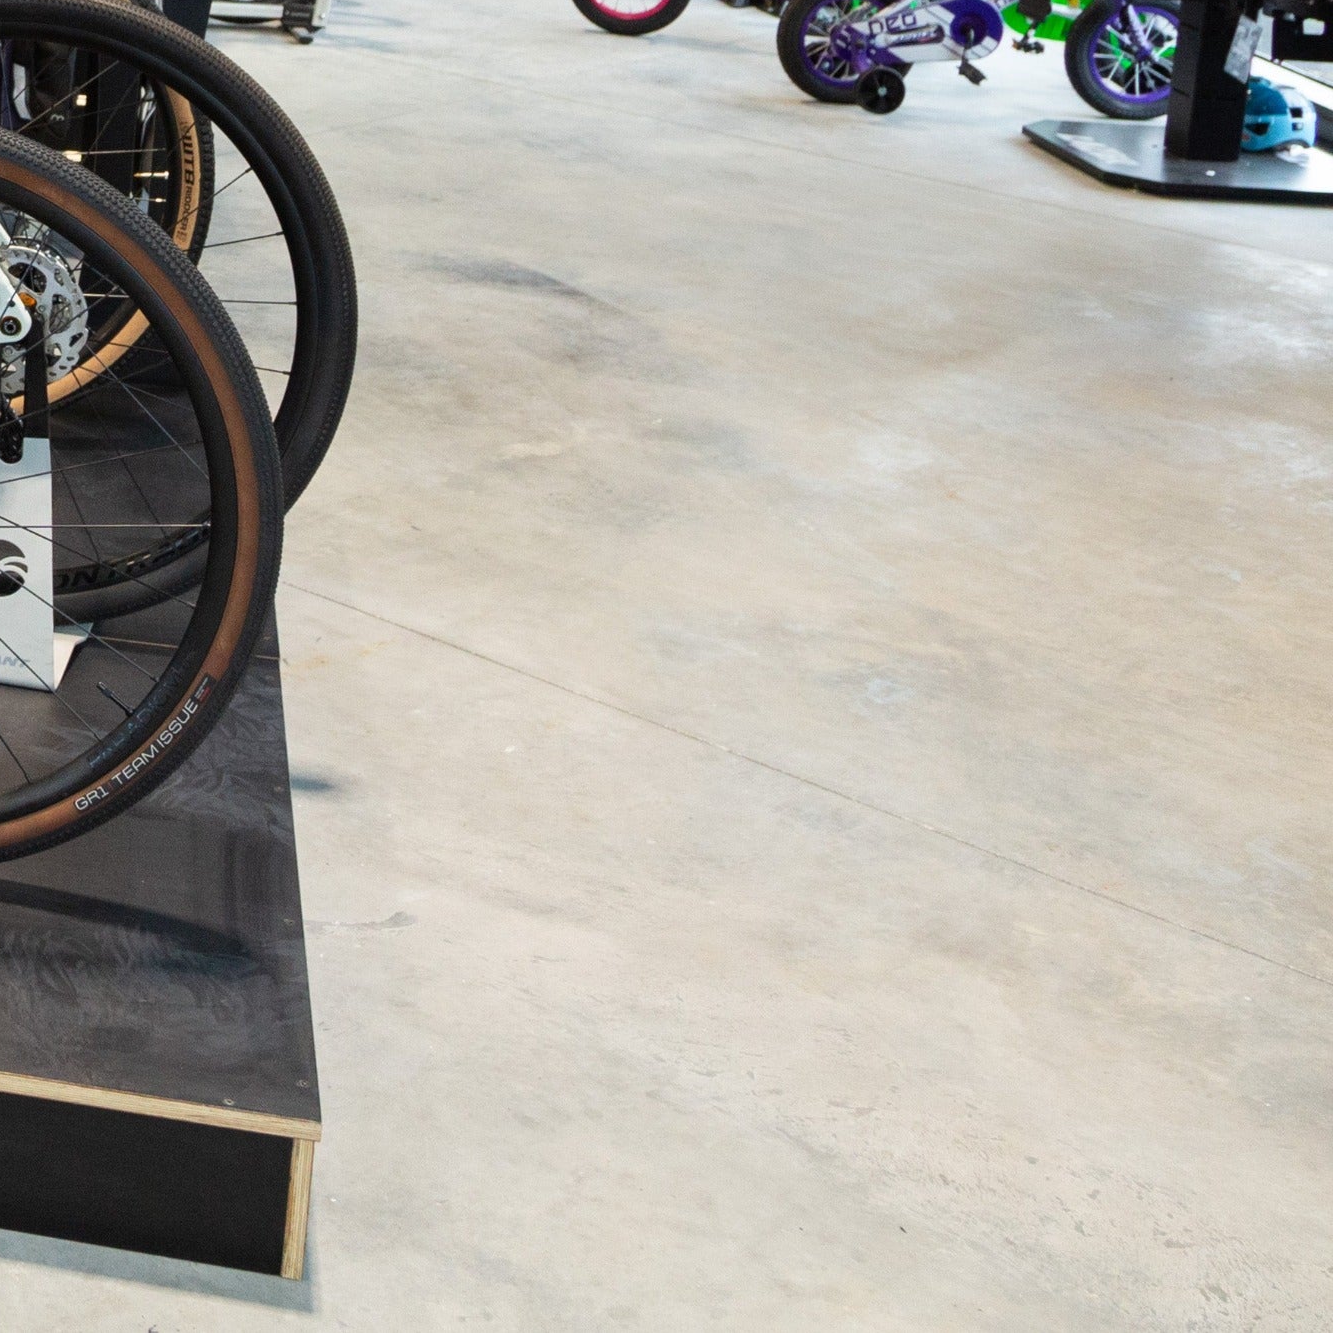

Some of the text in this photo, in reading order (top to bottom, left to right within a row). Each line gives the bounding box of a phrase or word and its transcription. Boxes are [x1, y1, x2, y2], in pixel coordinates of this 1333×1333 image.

[74, 785, 110, 811] GR1
[111, 744, 160, 785] TEAM
[156, 698, 199, 749] ISSUE
